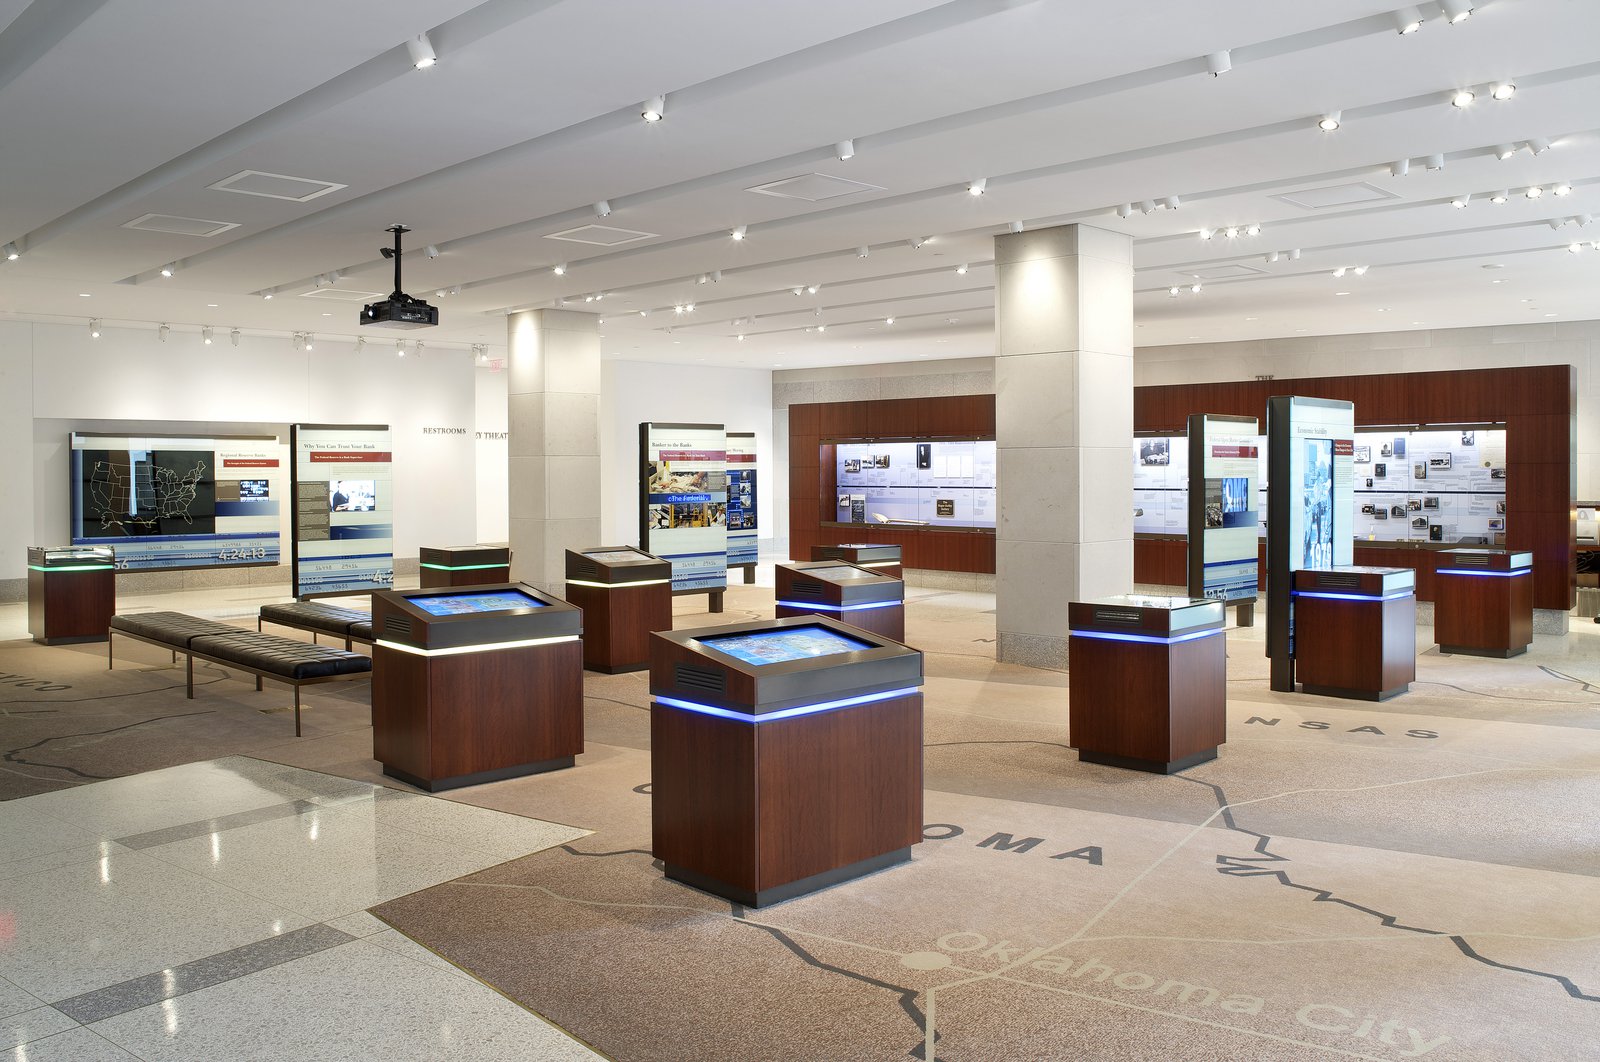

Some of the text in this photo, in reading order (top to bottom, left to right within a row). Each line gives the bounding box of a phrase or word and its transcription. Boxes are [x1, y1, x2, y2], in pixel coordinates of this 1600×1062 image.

[423, 427, 467, 435] RESTROOMS
[303, 443, 315, 451] Why
[936, 931, 1453, 1056] Oklahoma City
